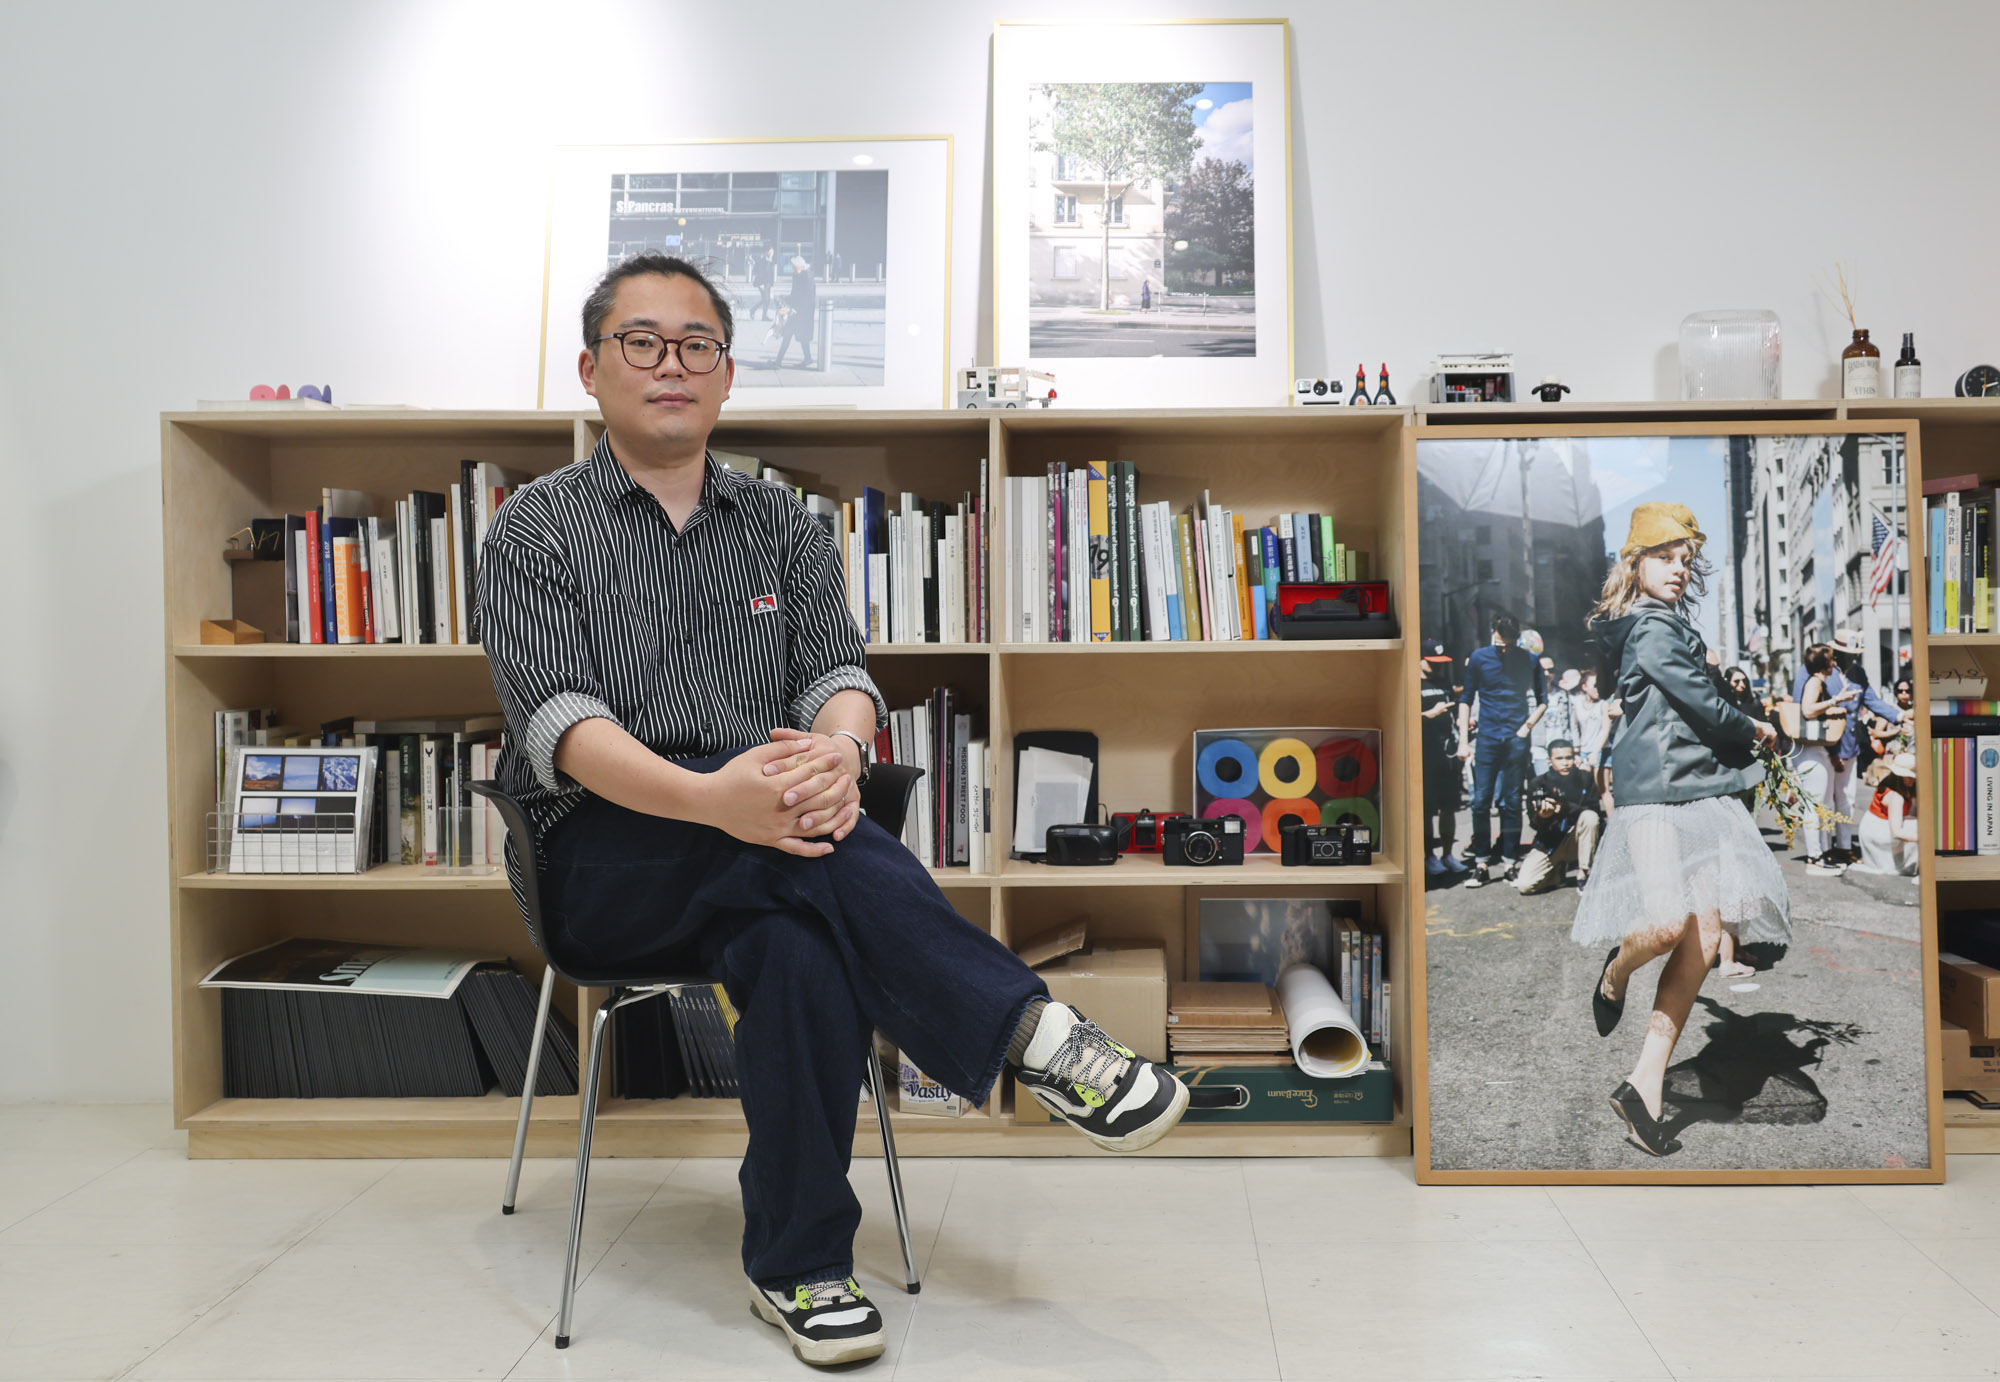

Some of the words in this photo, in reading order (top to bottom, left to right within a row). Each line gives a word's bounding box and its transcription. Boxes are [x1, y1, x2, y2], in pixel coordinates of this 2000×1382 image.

[628, 200, 673, 213] Pancras
[1986, 803, 1993, 811] IN
[909, 1080, 952, 1102] Vastly
